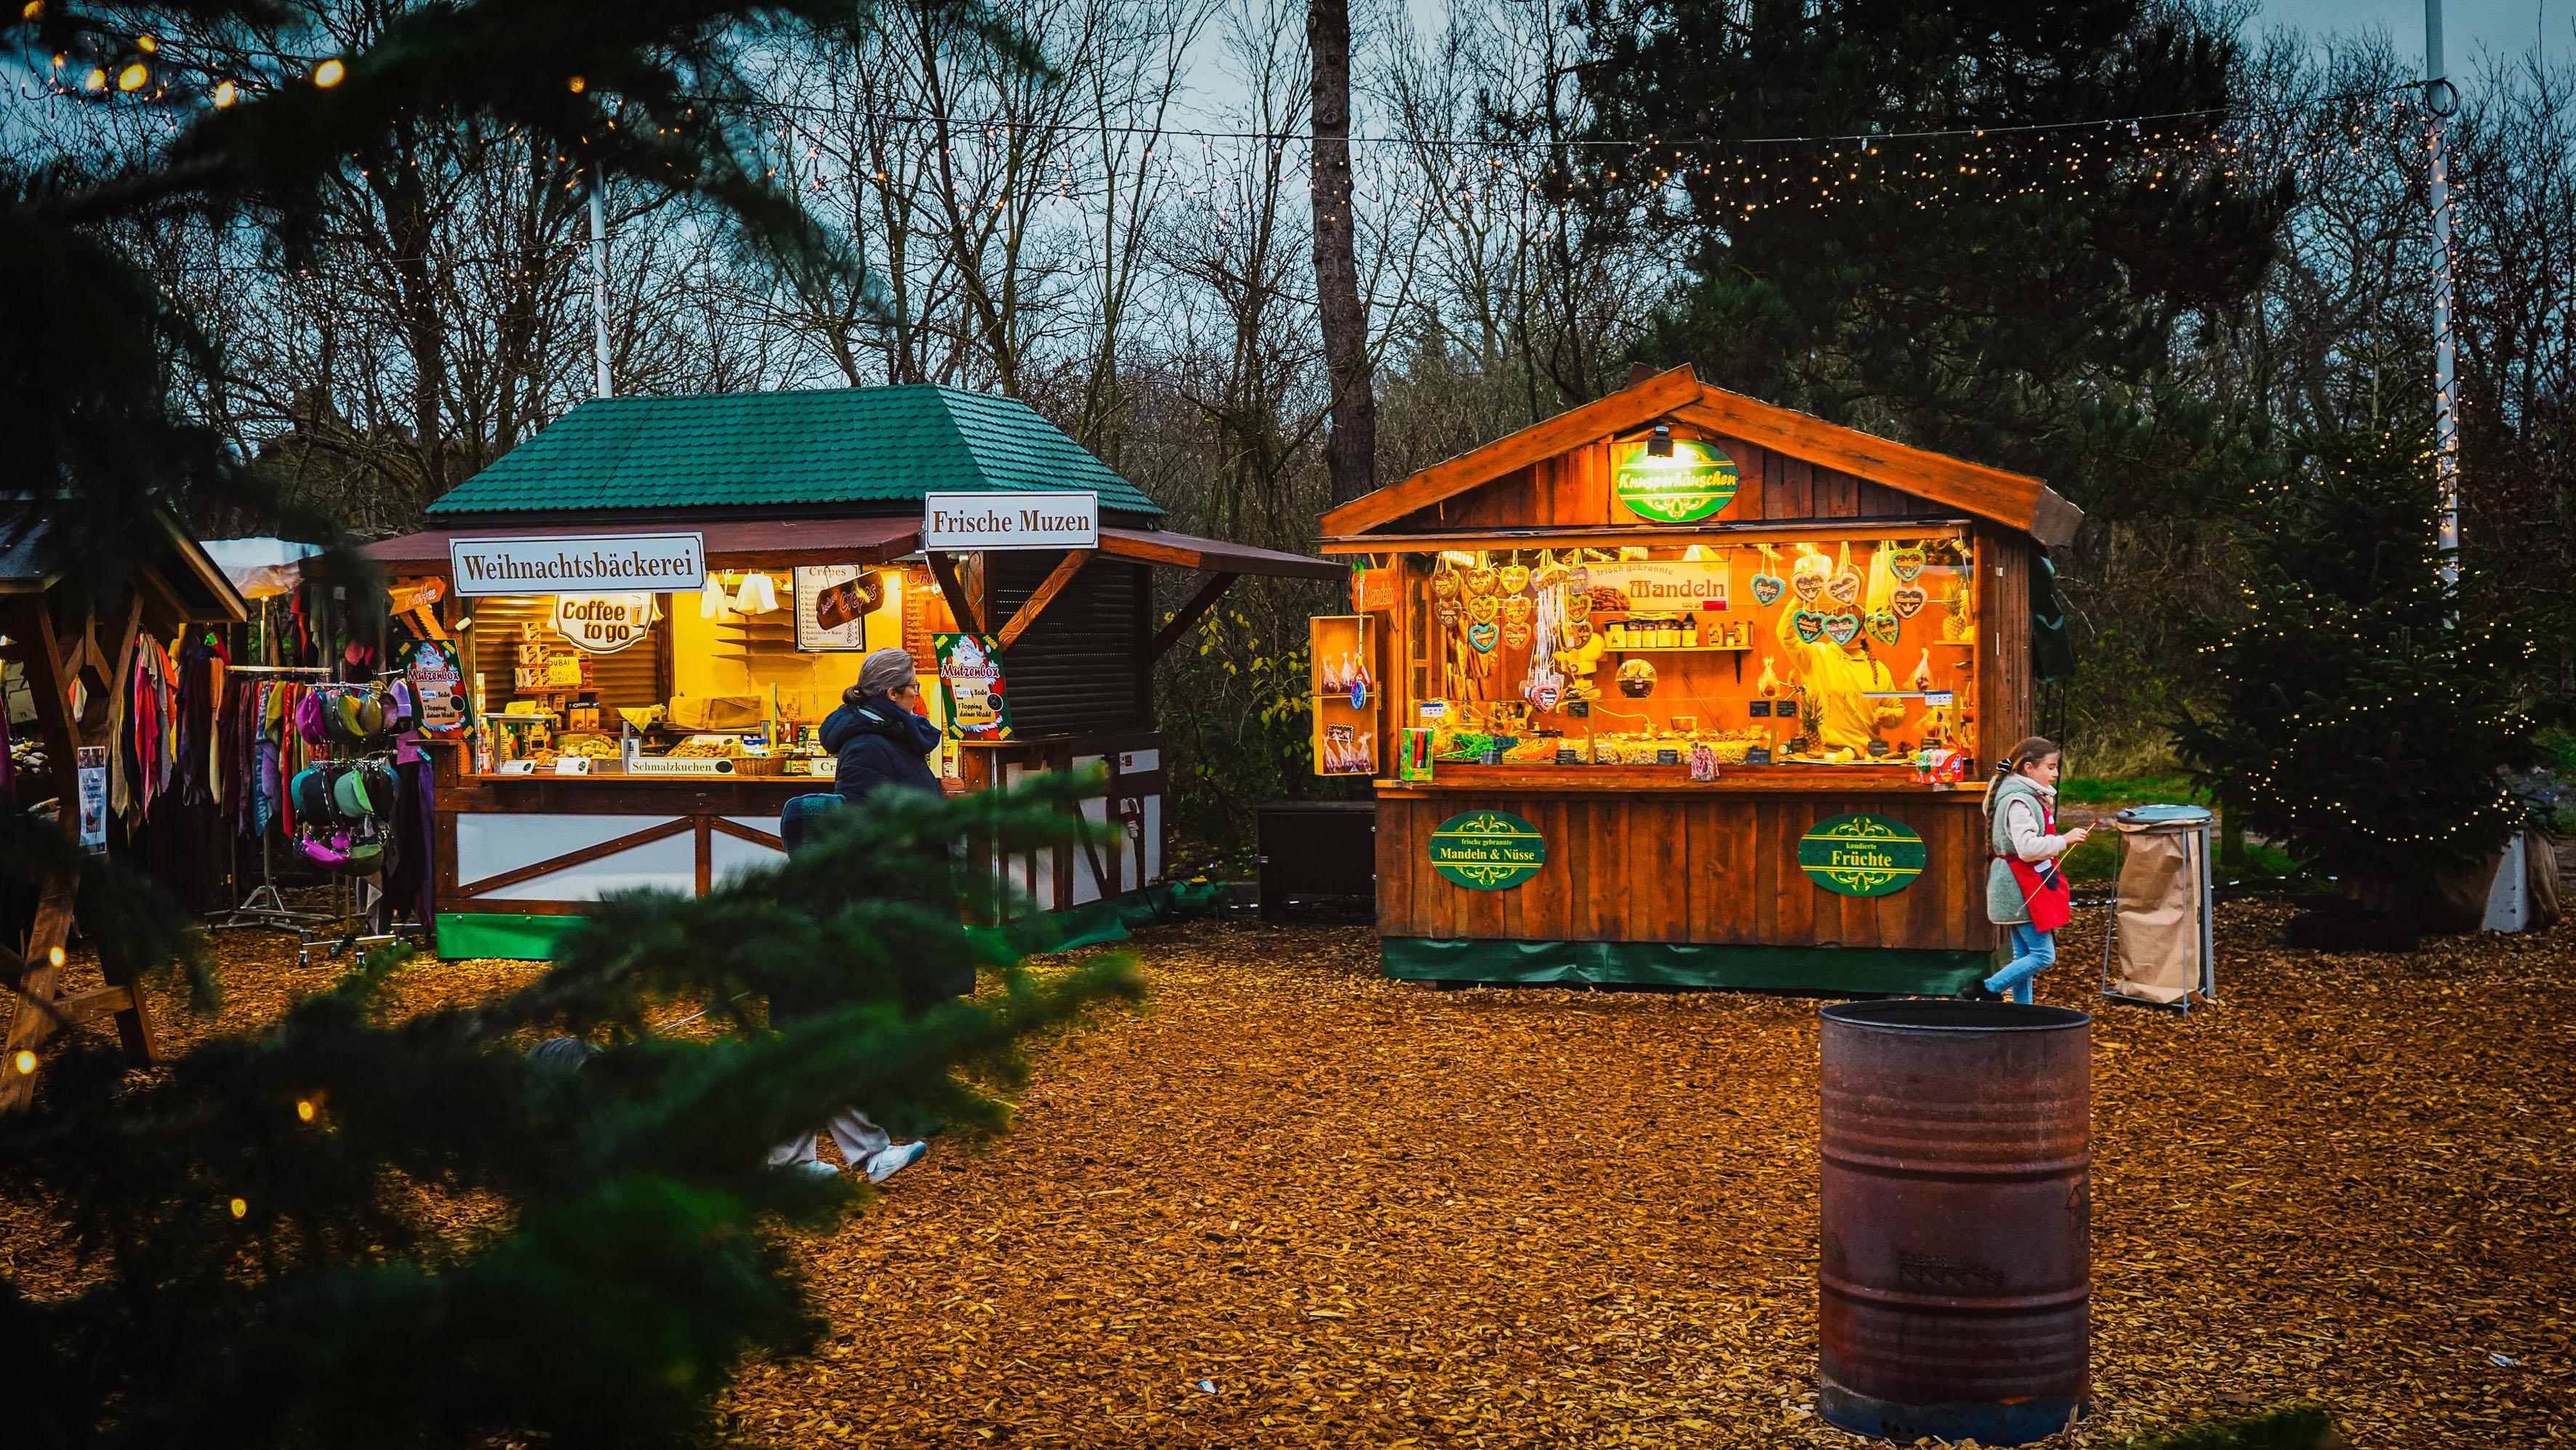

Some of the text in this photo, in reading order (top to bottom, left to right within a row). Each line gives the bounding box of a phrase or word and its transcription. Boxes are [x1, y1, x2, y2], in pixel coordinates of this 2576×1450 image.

[933, 510, 1090, 532] Frische Muzen
[463, 549, 694, 580] Weihnachtsbäckerei
[1626, 564, 1674, 575] gebrannte
[405, 582, 436, 607] Kaffee
[1629, 580, 1726, 598] Mandeln
[563, 601, 625, 621] Coffee
[584, 622, 630, 642] to go
[407, 668, 460, 682] Mutzenbox
[941, 663, 1000, 678] Mutzenbox
[632, 761, 712, 772] Schmalzkuchen
[1440, 848, 1535, 860] Mandeln & Nüsse
[1831, 850, 1893, 867] Früchte
